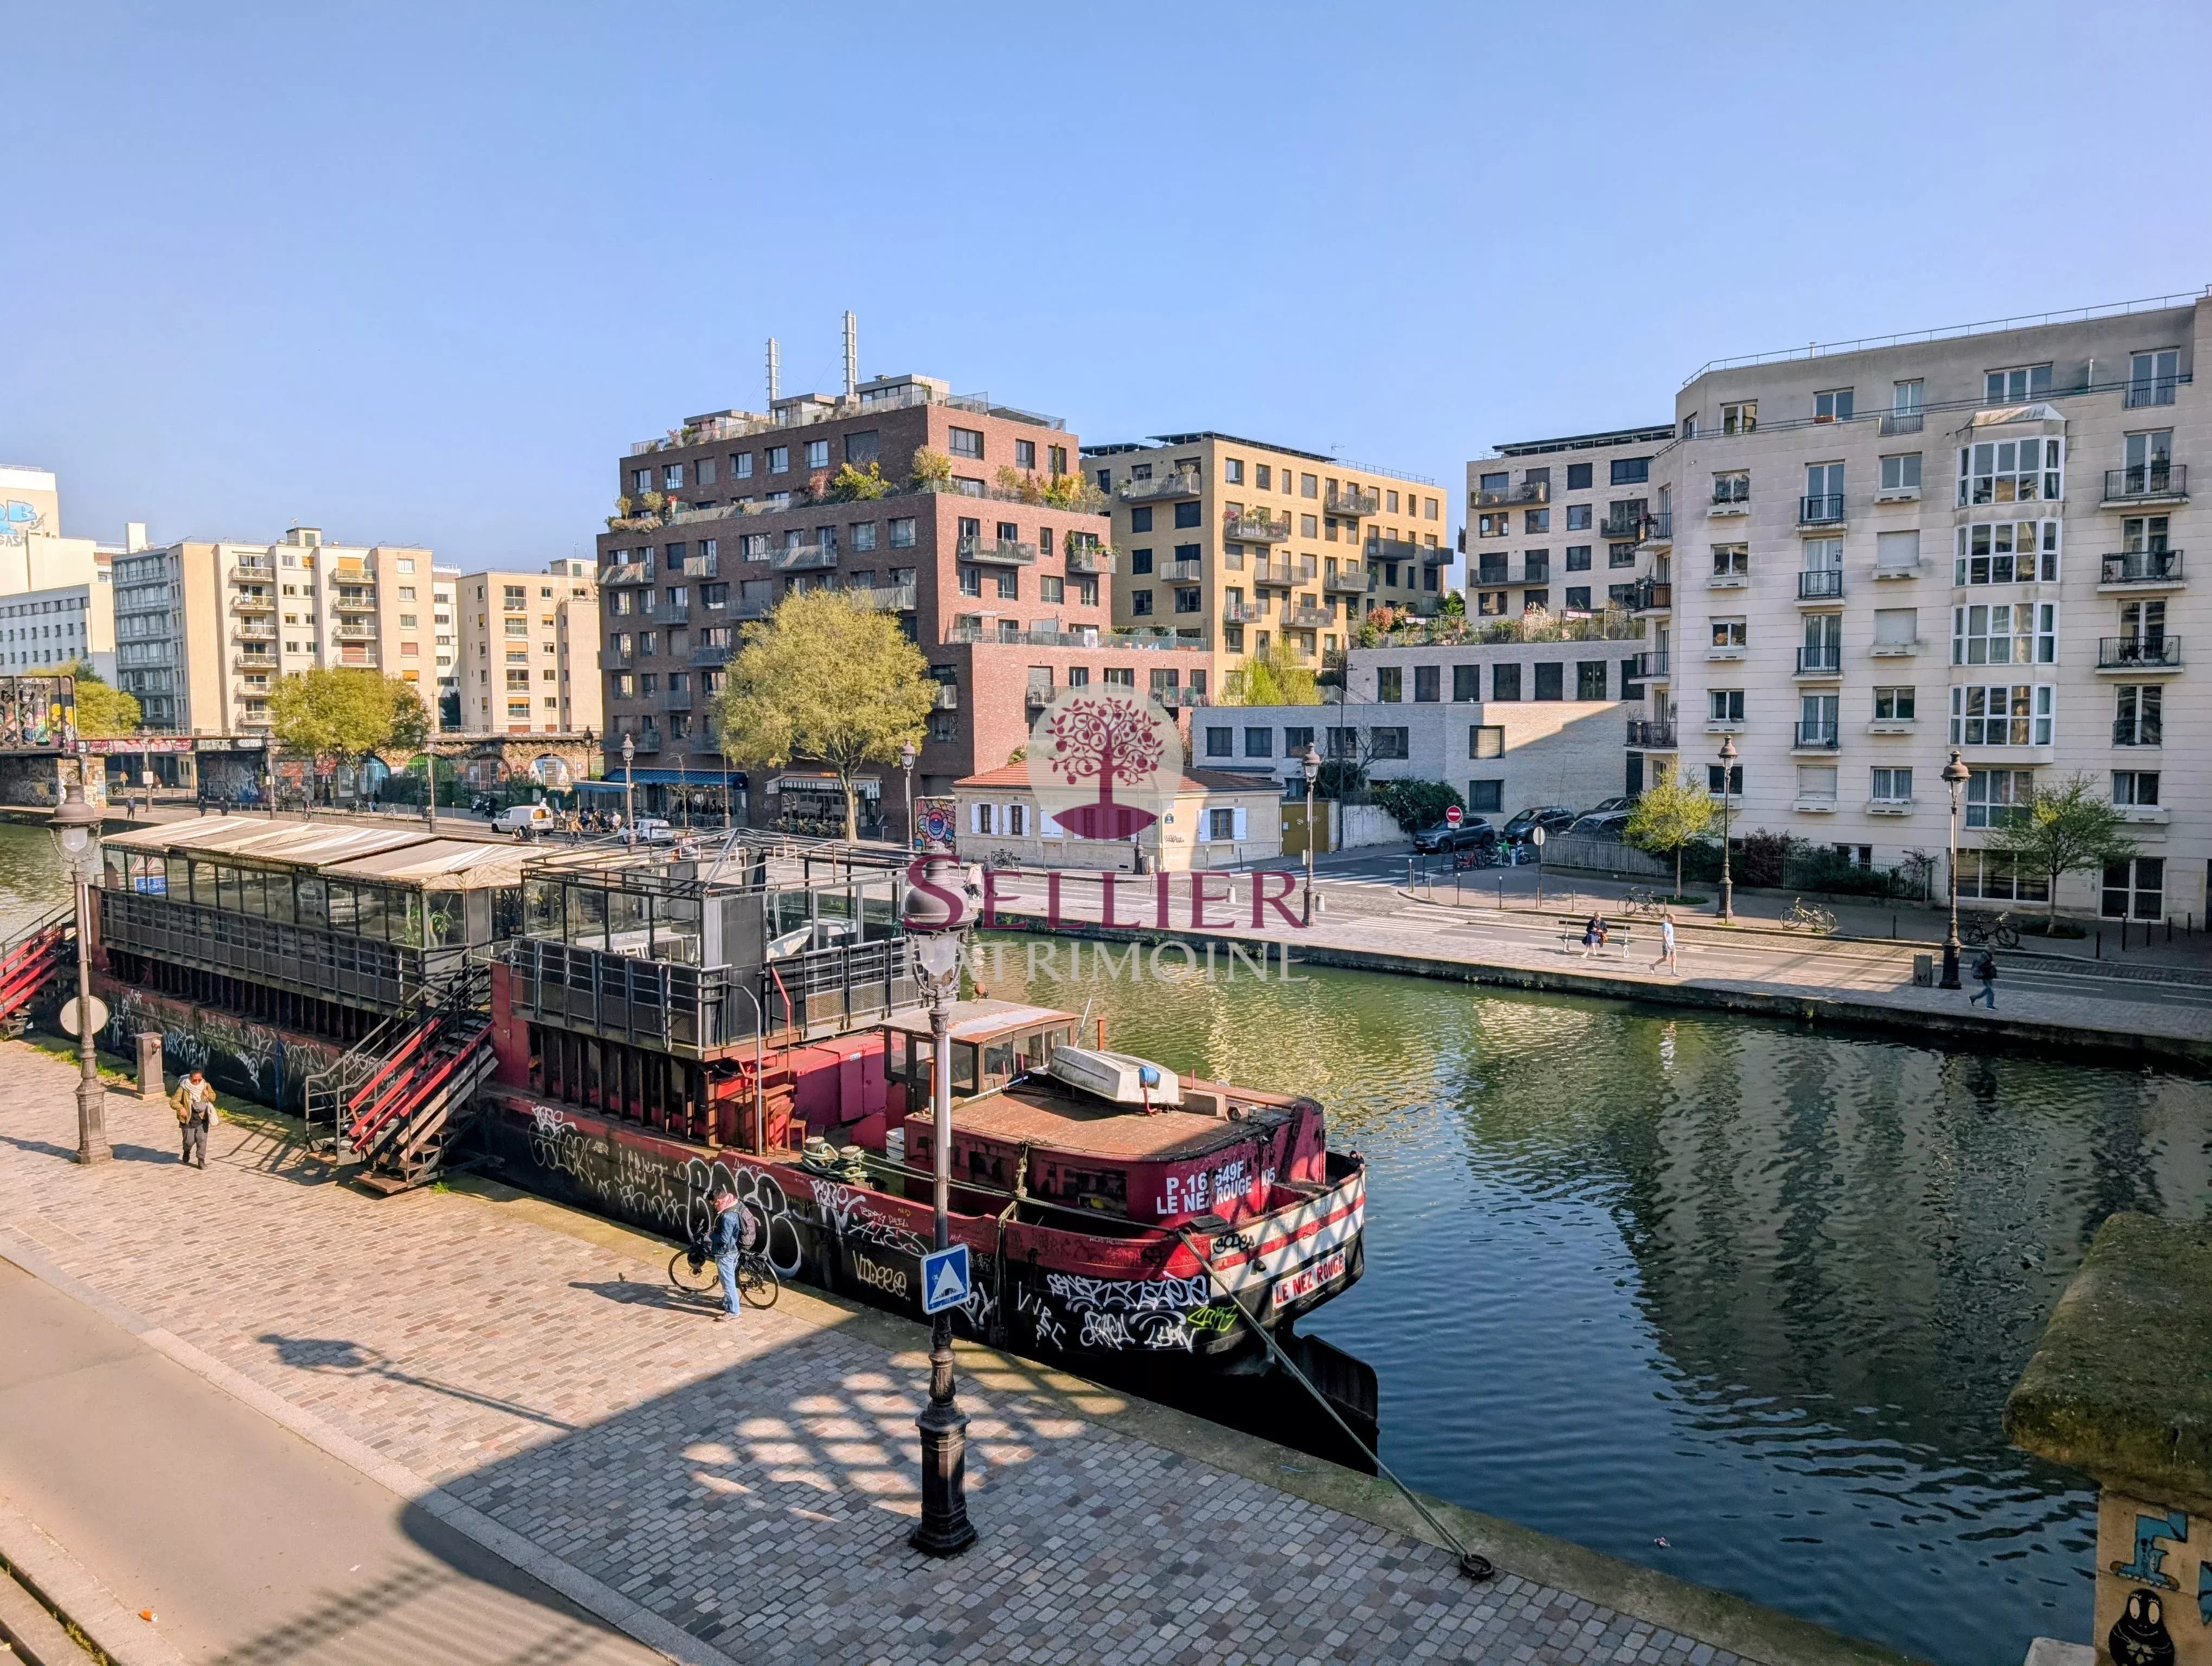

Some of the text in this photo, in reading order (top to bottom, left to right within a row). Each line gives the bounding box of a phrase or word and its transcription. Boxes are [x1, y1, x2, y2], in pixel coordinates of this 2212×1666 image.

[1156, 1195, 1178, 1214] LE
[1216, 1175, 1252, 1205] ROUGE
[1275, 1253, 1343, 1304] LE NEZ ROUGE
